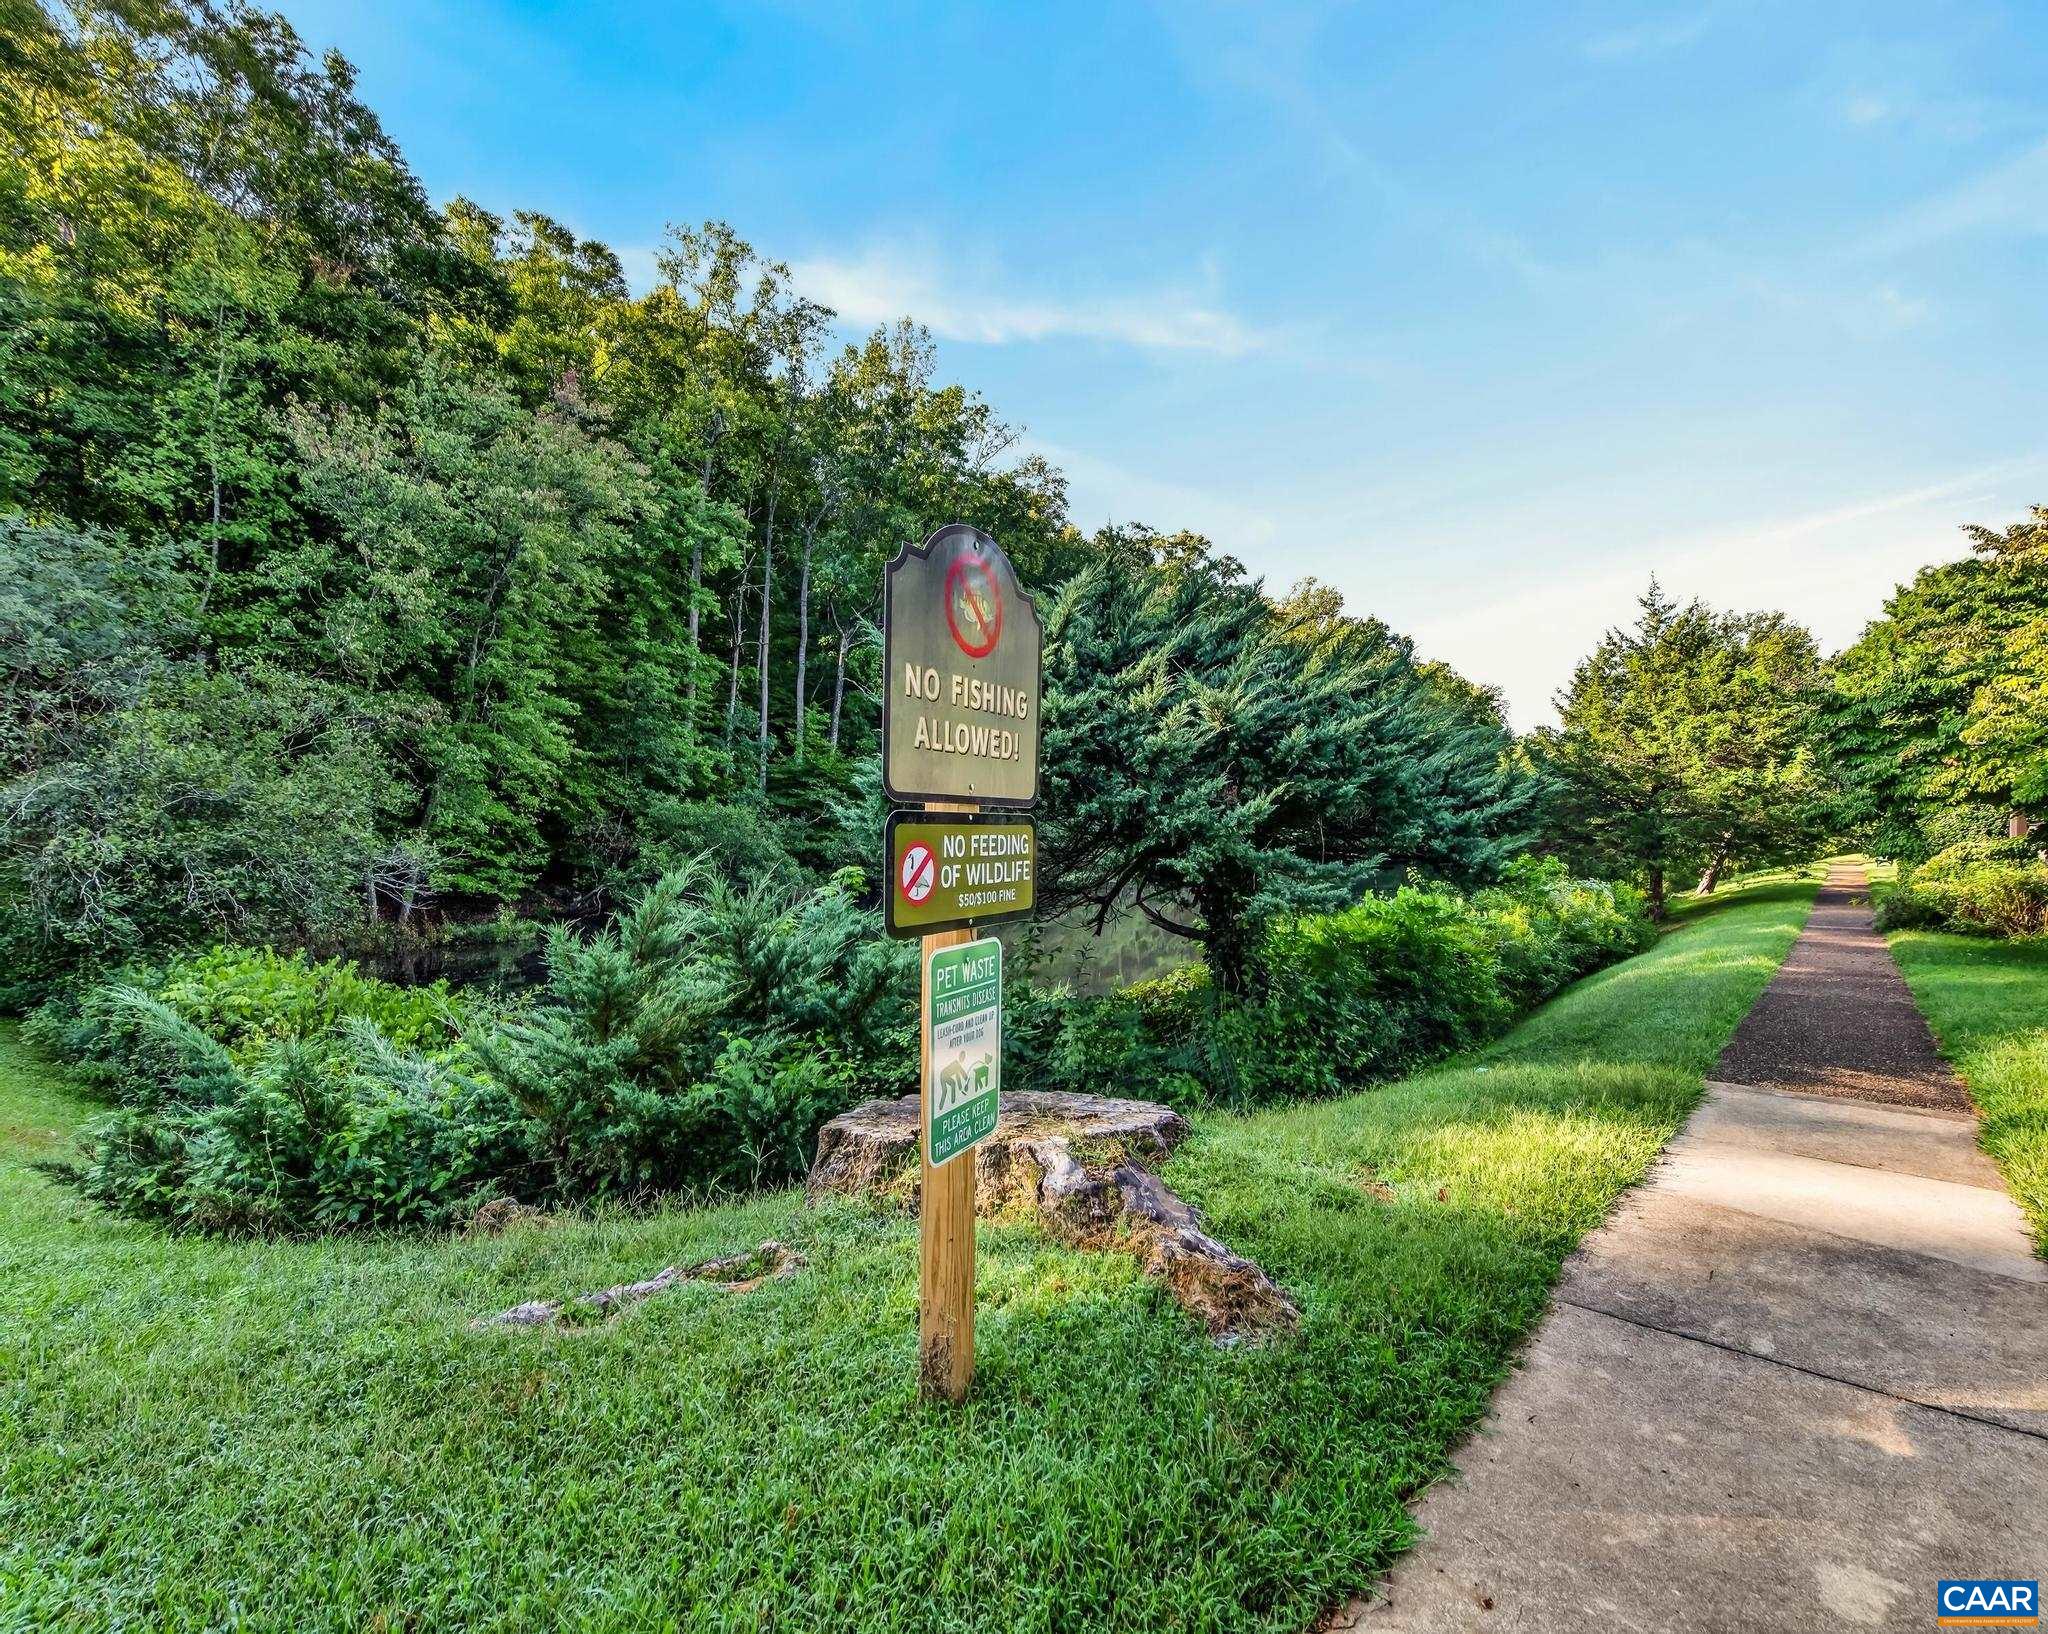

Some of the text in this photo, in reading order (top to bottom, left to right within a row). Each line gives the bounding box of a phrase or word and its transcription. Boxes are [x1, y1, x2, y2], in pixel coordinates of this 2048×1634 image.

[905, 662, 1028, 720] NO FISHING
[914, 716, 1020, 761] ALLOWED!
[943, 834, 1029, 858] NO FEEDING
[940, 860, 1031, 889] OF WILDLIFE
[958, 888, 1016, 908] $50/$100 FINE
[937, 956, 996, 991] PET WASTE
[936, 986, 996, 1018] TRANSMITS DISEASE
[942, 1098, 990, 1135] PLEASE KEEP
[935, 1111, 996, 1158] THIS AREA CLEAN
